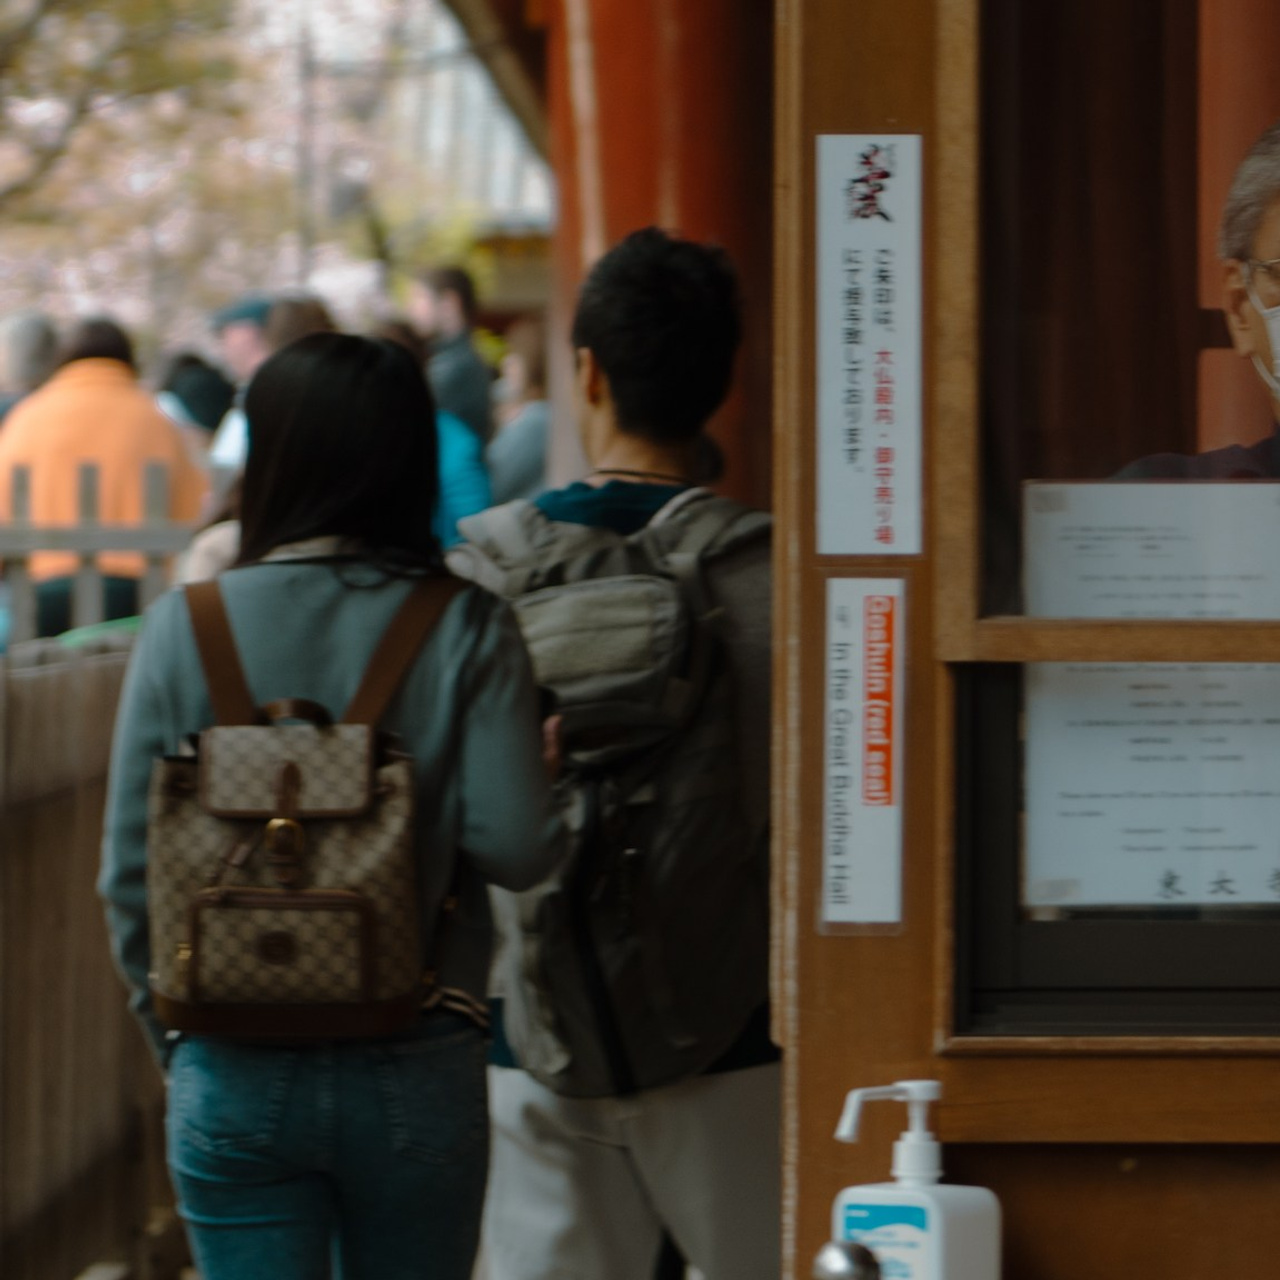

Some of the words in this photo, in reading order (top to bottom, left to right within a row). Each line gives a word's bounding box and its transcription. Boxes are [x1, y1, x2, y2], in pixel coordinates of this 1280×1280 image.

[831, 642, 851, 660] In
[865, 596, 892, 692] Goshuin
[831, 668, 851, 700] the
[830, 707, 851, 767] Great
[863, 699, 892, 744] (red
[864, 750, 891, 806] seal)
[830, 775, 851, 856] Buddha
[830, 864, 851, 905] Hall
